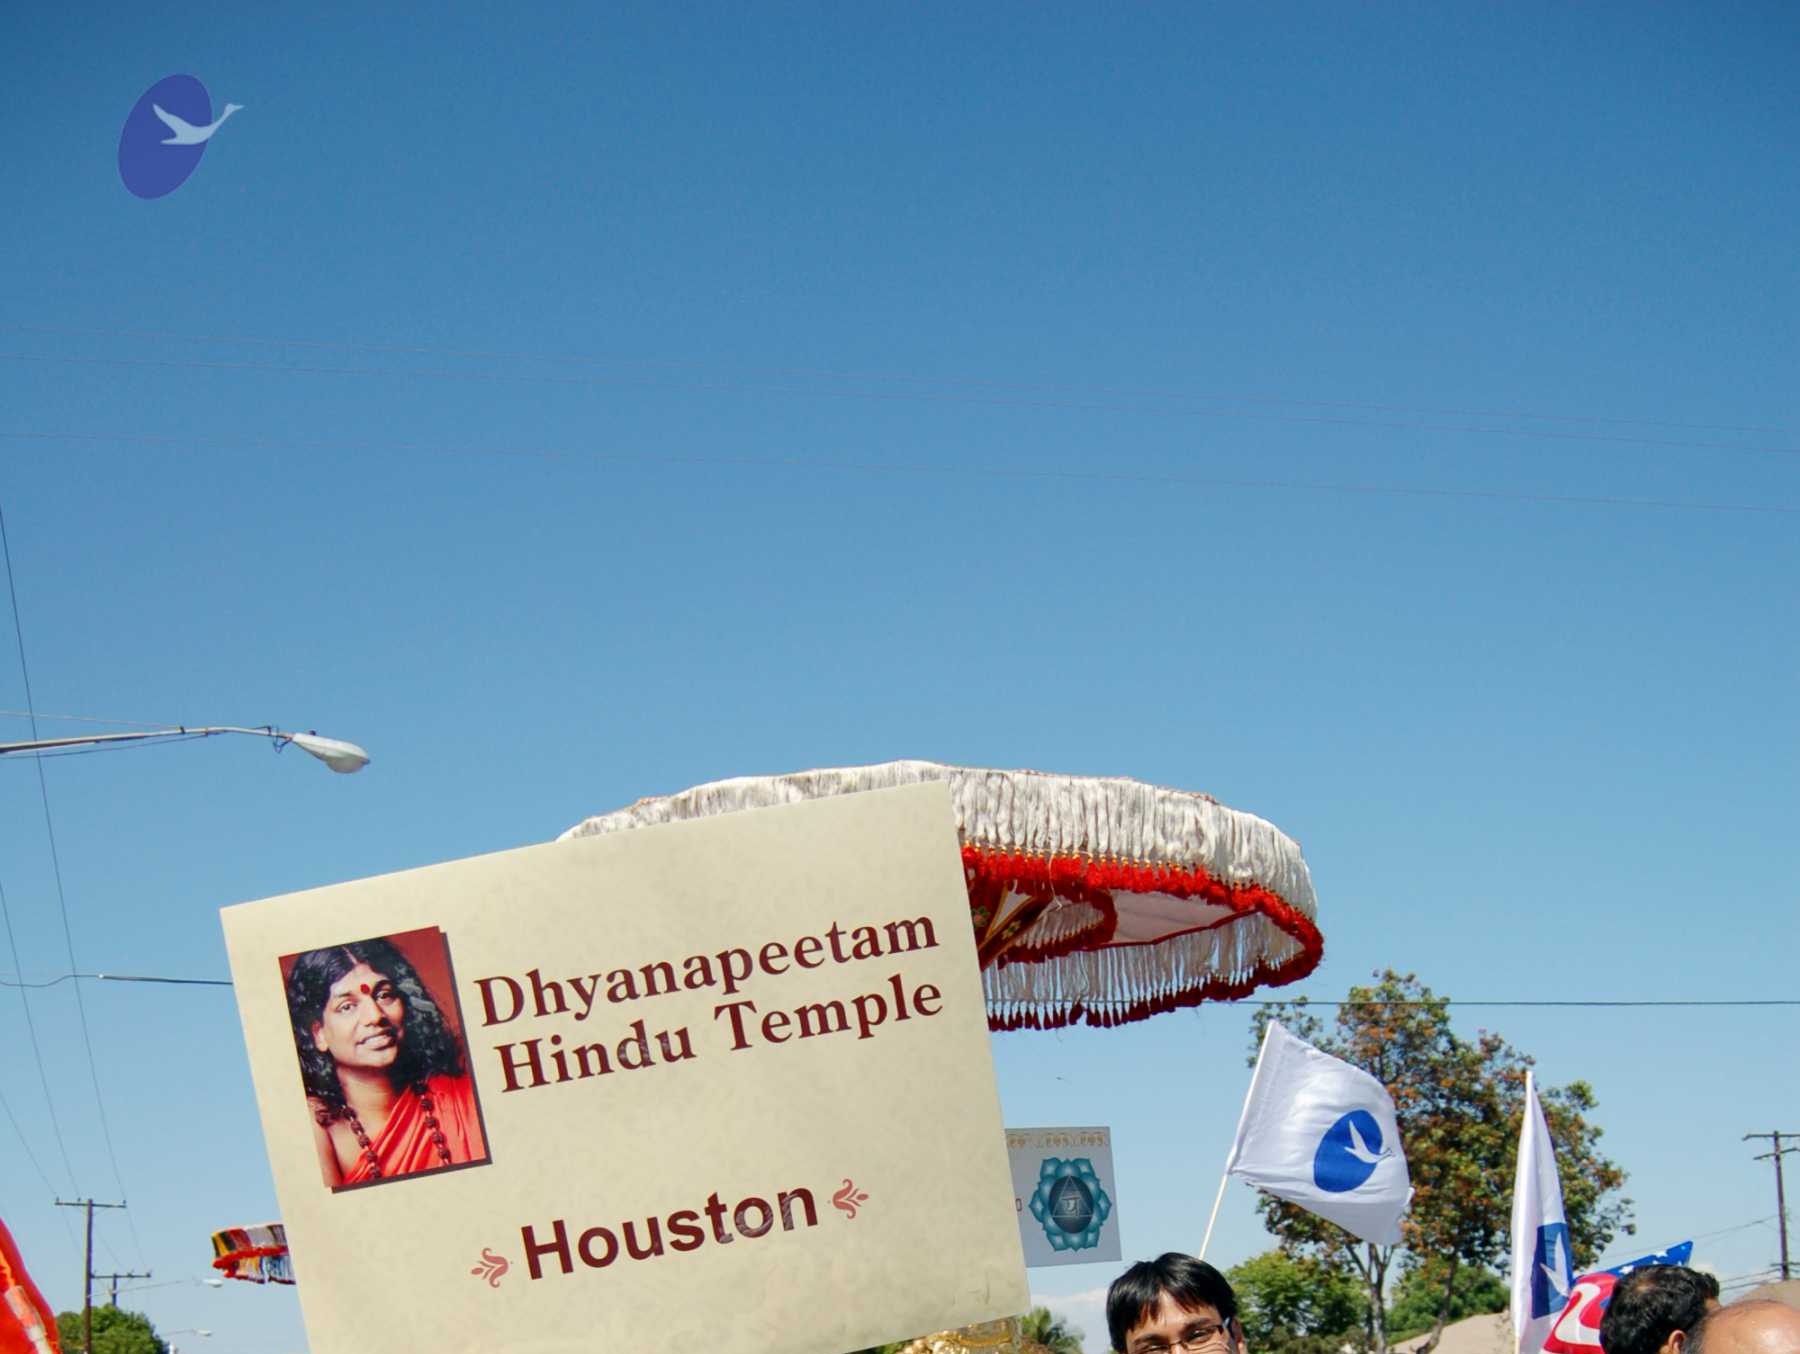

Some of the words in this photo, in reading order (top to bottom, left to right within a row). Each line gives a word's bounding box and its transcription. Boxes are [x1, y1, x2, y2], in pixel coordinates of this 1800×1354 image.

[473, 915, 940, 1027] Dhyanapeetam
[493, 1020, 697, 1094] Hindu
[713, 973, 944, 1052] Temple
[521, 1184, 818, 1281] Houston
